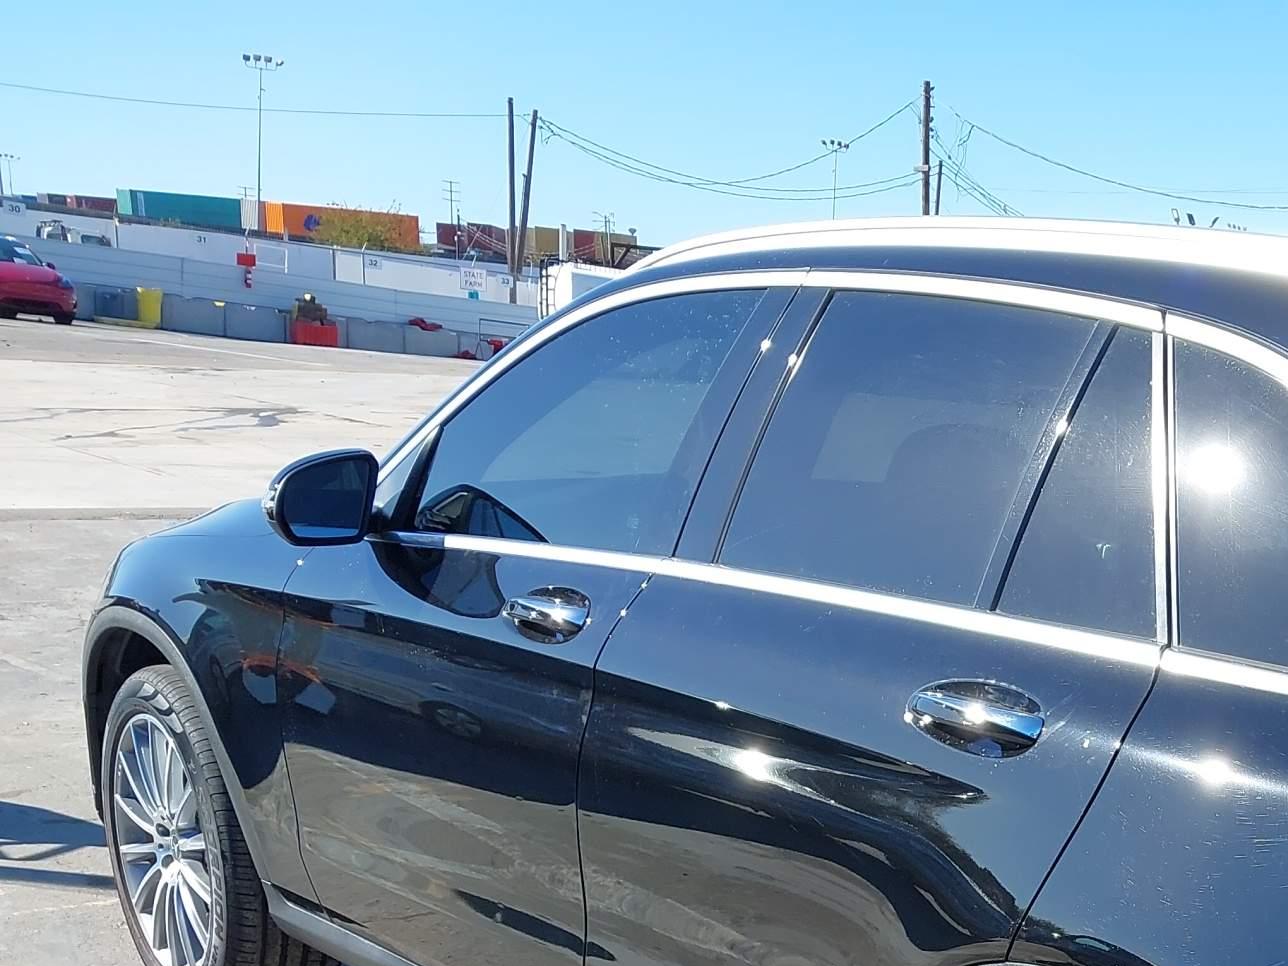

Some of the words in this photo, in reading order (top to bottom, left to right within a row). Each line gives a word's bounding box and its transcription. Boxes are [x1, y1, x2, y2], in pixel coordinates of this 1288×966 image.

[8, 204, 21, 214] 30
[197, 235, 207, 244] 31
[367, 259, 378, 267] 32
[463, 270, 485, 280] STATE
[464, 279, 483, 288] FARM
